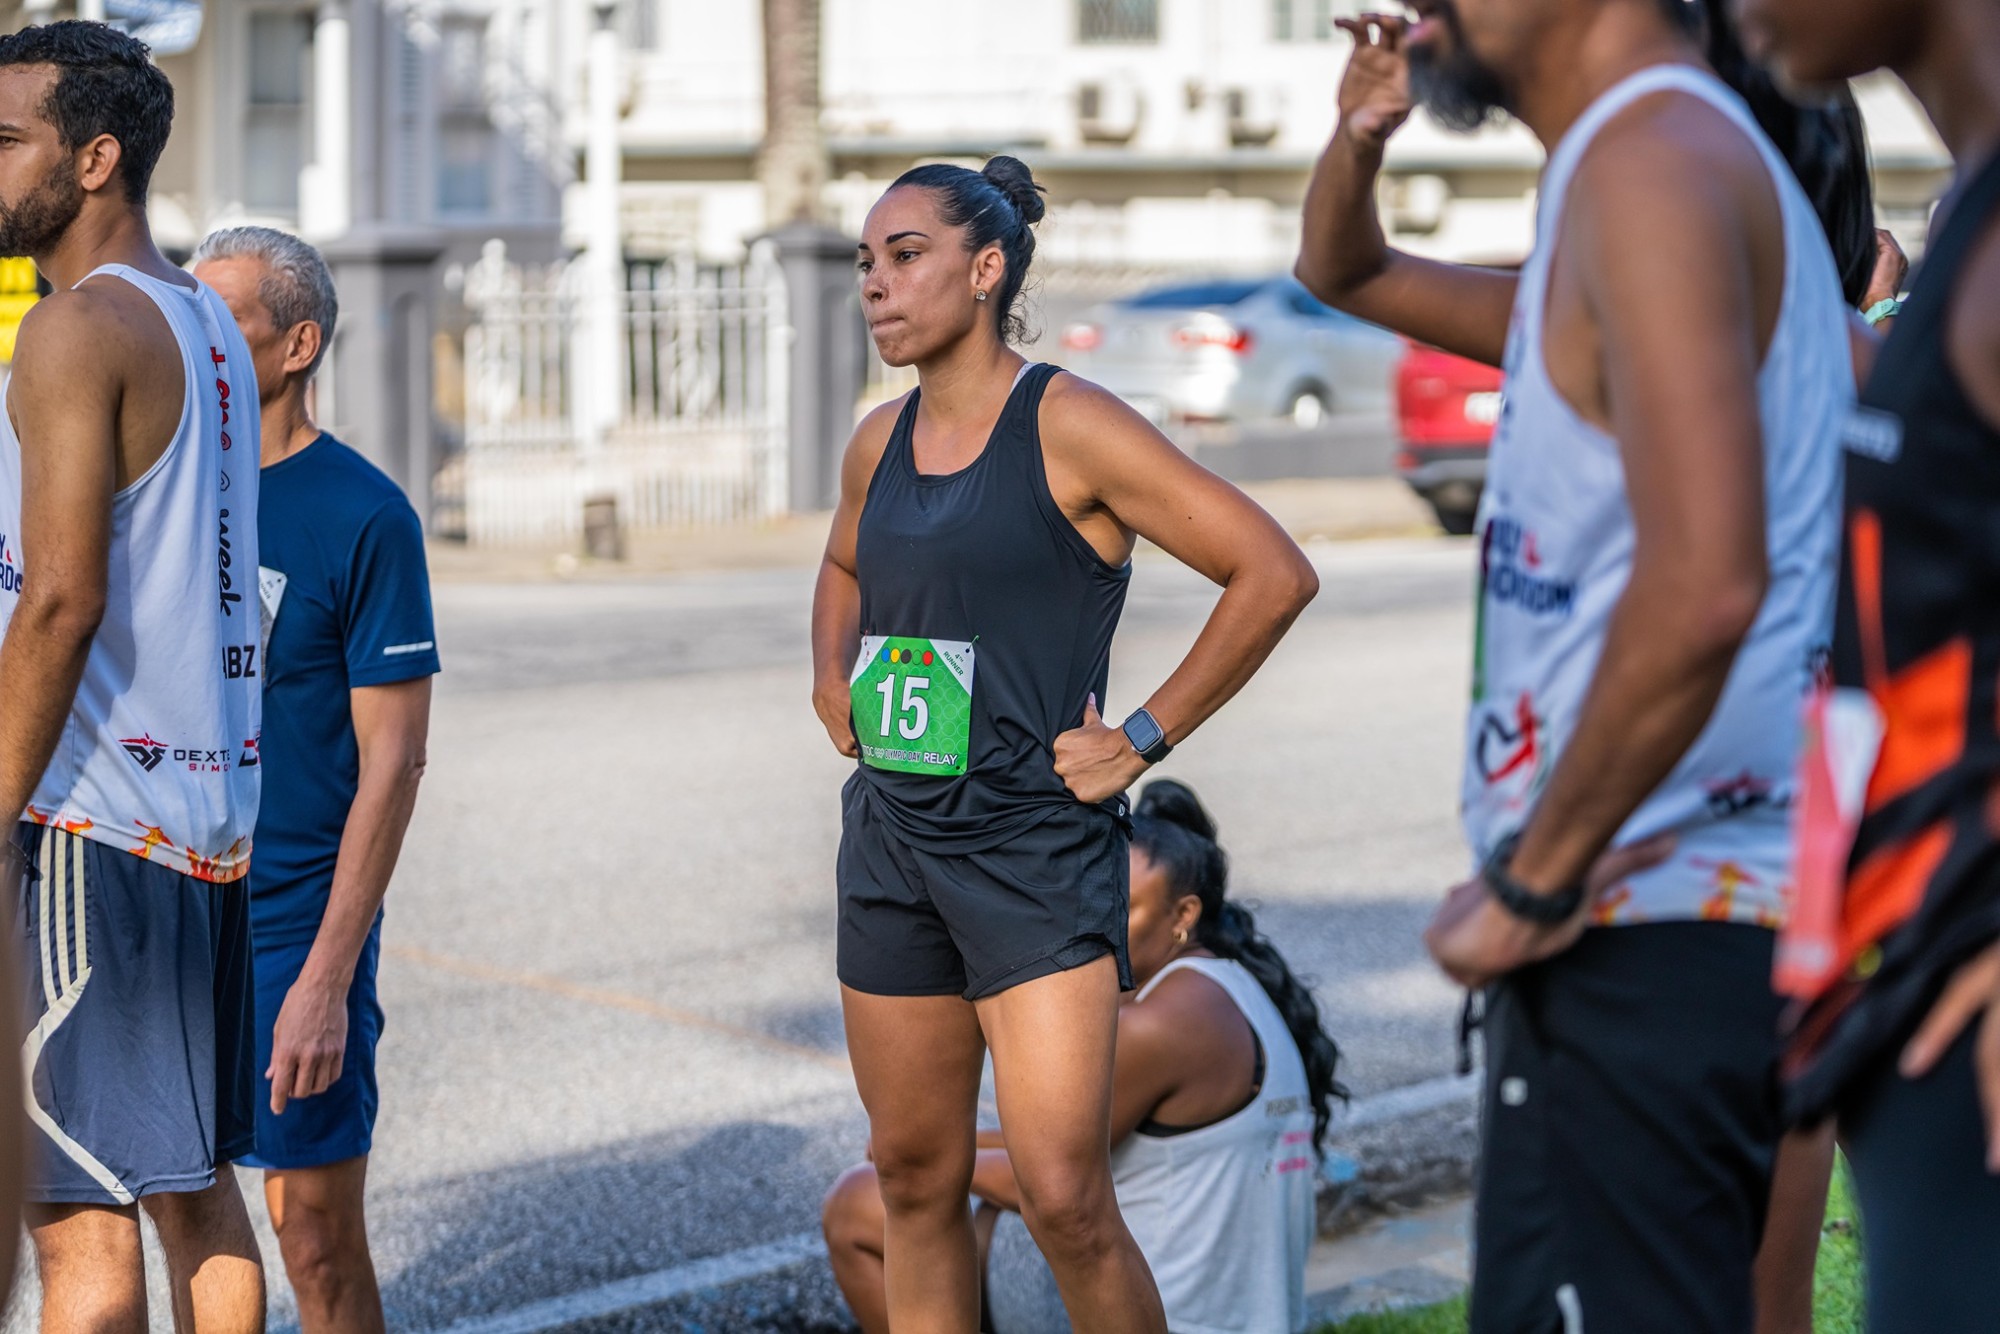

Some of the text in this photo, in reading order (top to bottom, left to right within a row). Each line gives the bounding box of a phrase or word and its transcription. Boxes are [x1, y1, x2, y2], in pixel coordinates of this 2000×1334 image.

[943, 651, 964, 676] RUNNER
[876, 672, 931, 740] 15
[885, 748, 906, 761] OLYMPIC
[908, 750, 921, 763] DAY
[923, 752, 958, 765] RELAY
